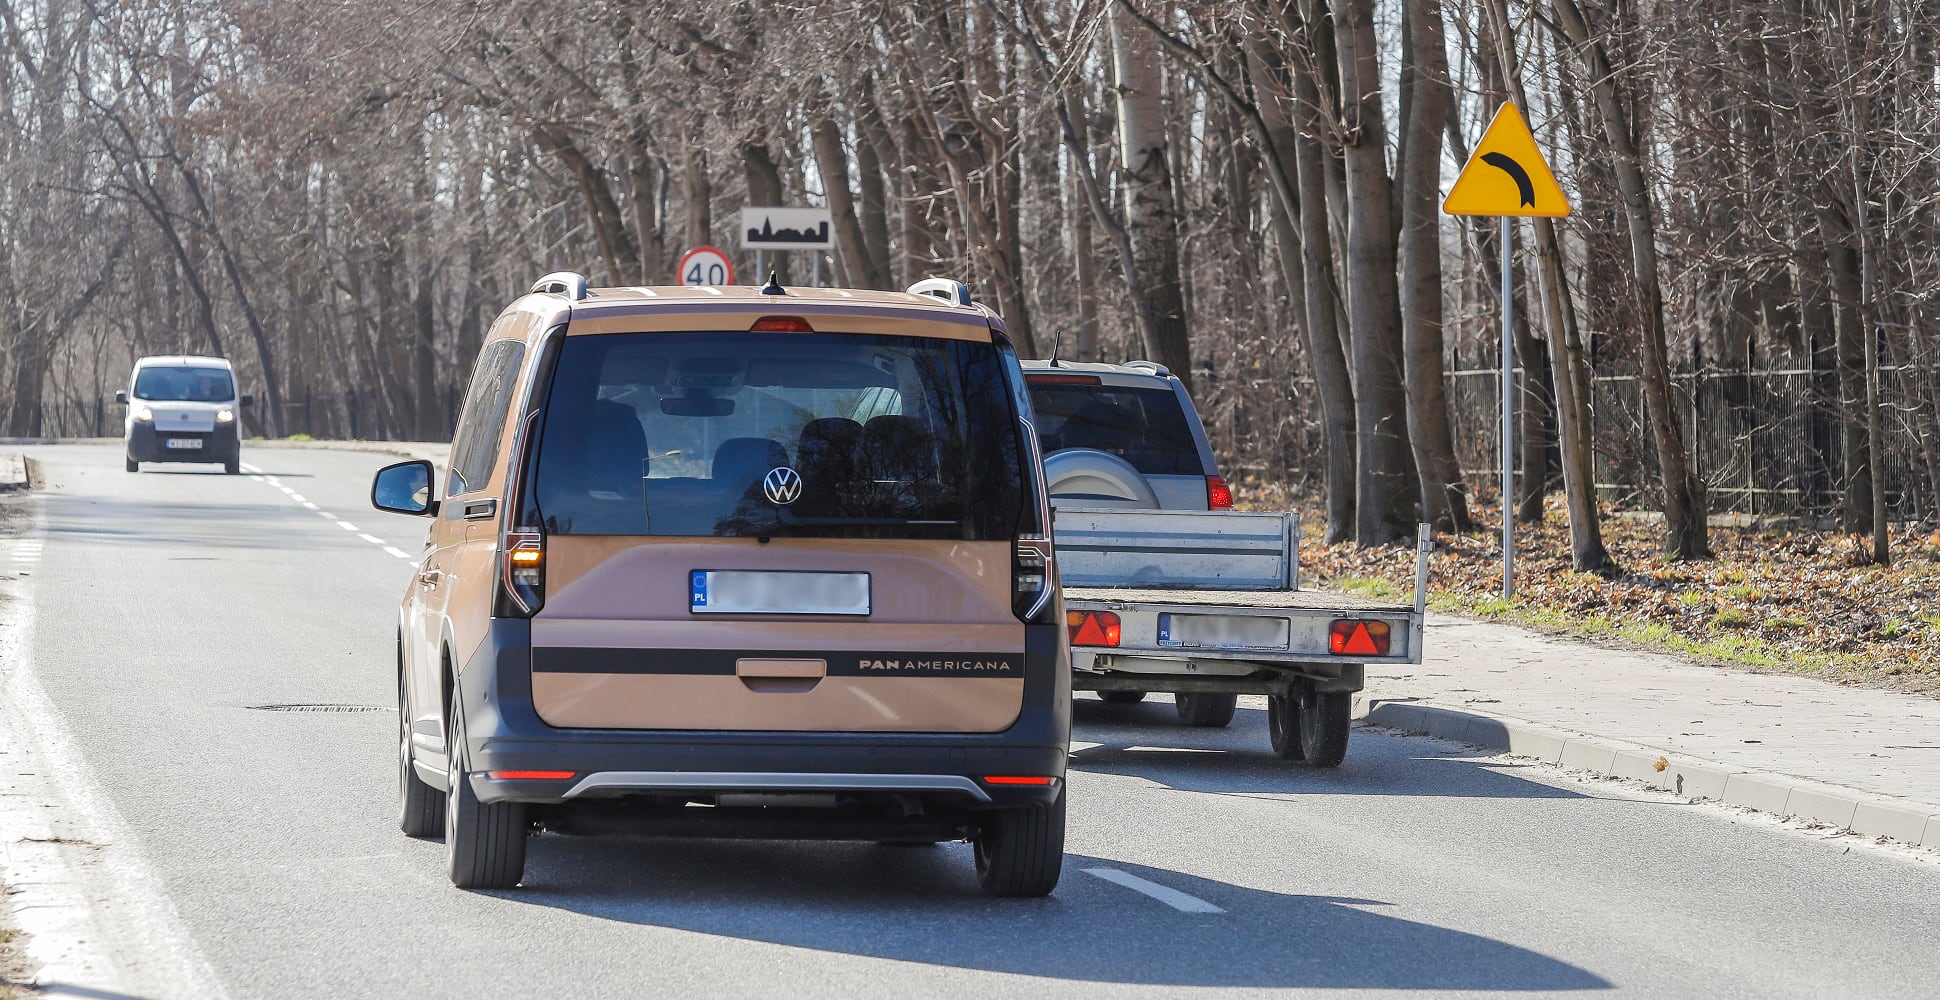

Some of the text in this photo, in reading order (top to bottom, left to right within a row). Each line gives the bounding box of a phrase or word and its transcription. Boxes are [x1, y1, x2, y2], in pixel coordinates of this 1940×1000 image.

[687, 263, 724, 286] 40
[694, 593, 706, 602] PL
[859, 659, 1011, 670] PAN AMERICANA
